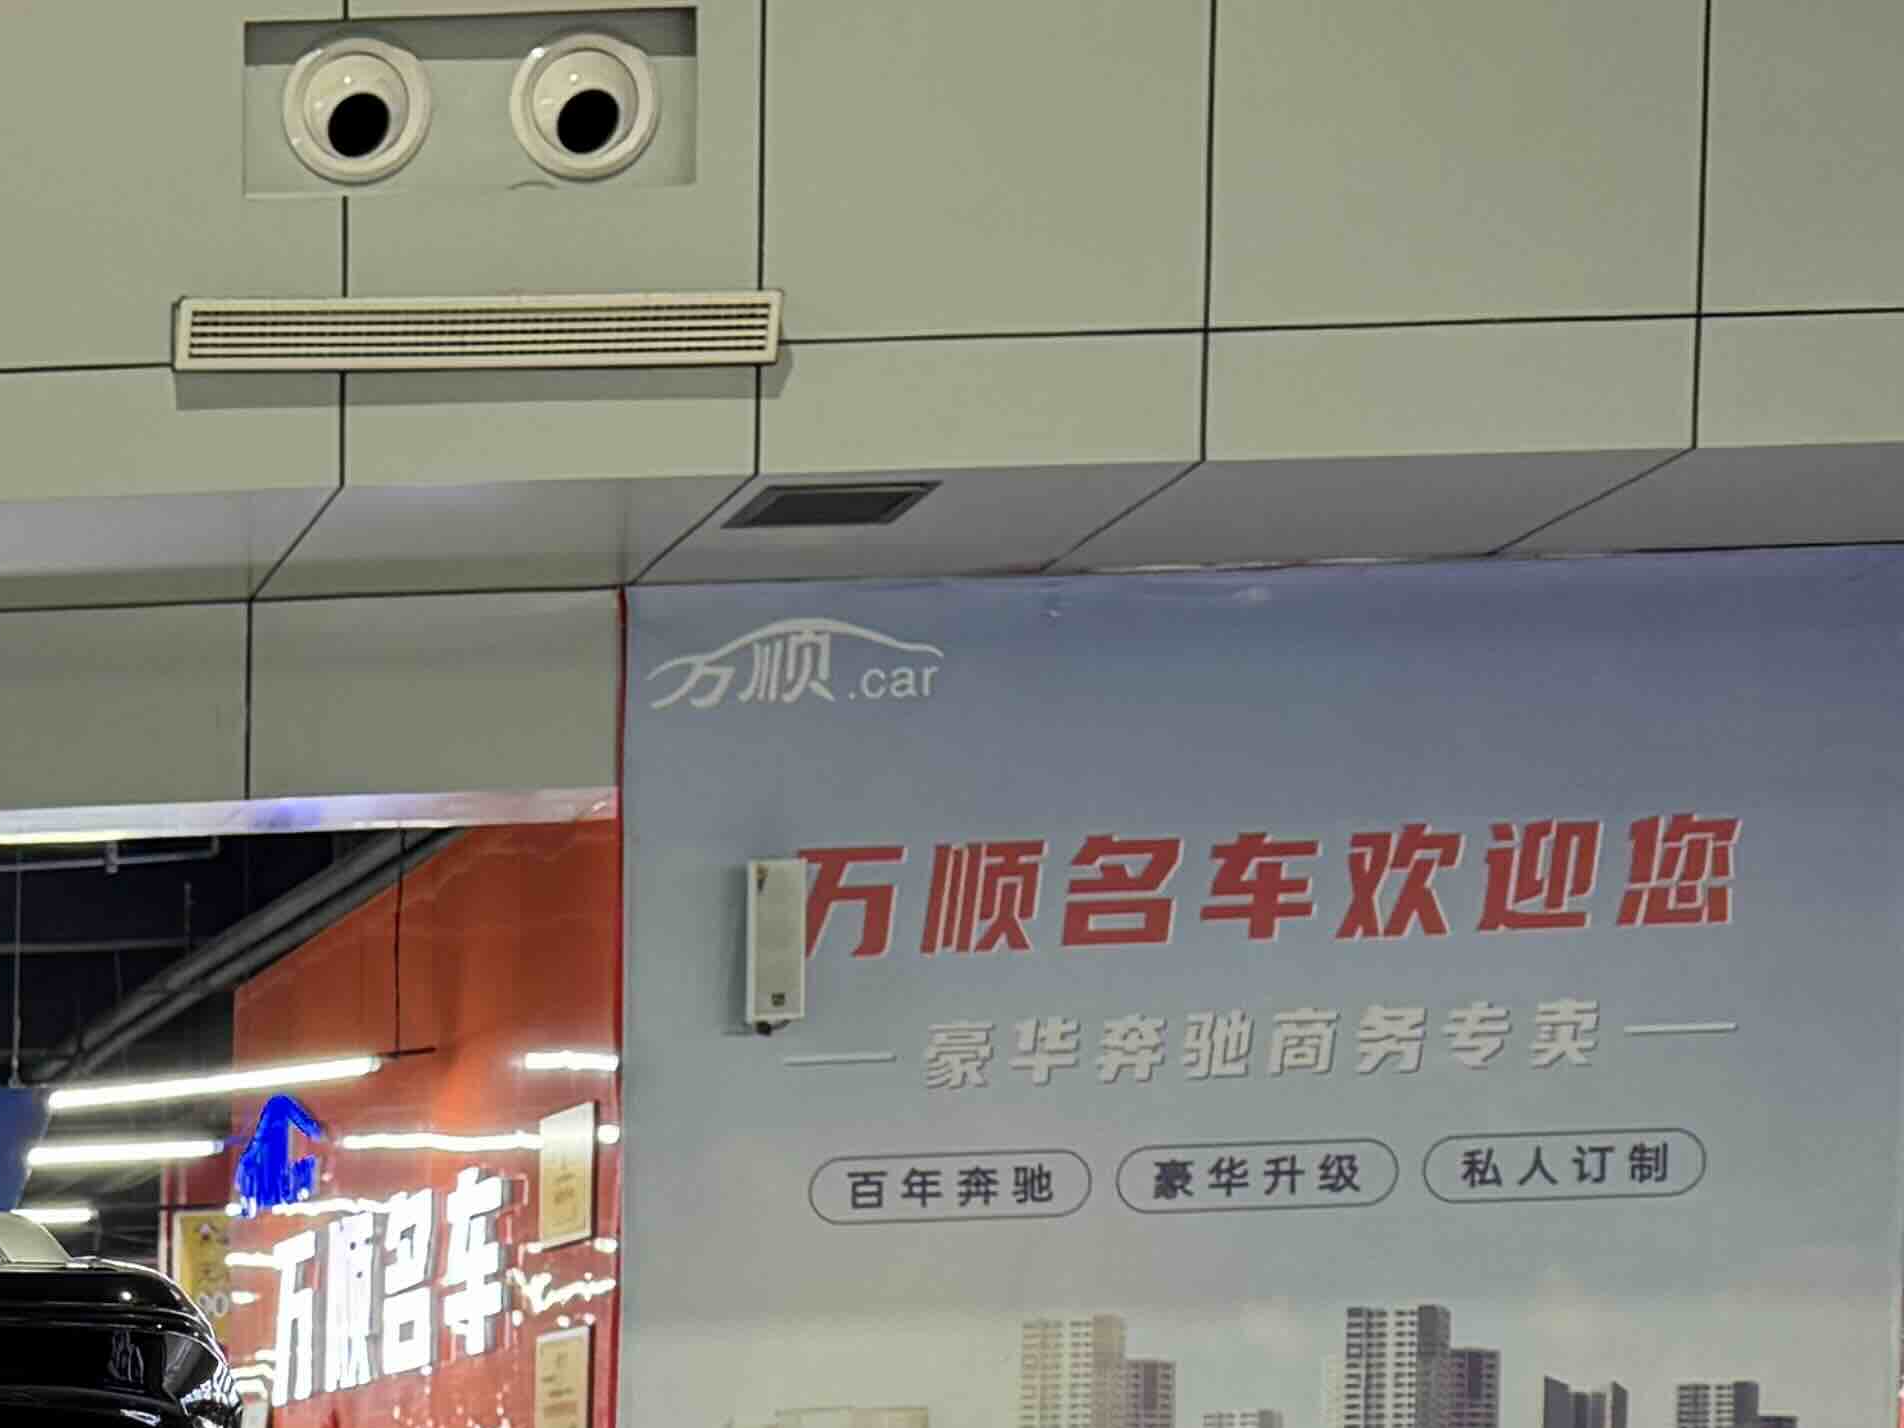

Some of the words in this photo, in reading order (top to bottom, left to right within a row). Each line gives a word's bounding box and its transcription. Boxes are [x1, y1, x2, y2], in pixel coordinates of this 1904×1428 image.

[797, 813, 1743, 958] 万顺名车欢迎您
[924, 998, 1602, 1090] 豪华奔驰商务专卖
[847, 1165, 1056, 1212] 百年奔驰
[1153, 1153, 1362, 1200] 豪华升级
[1461, 1143, 1670, 1190] 私人订制
